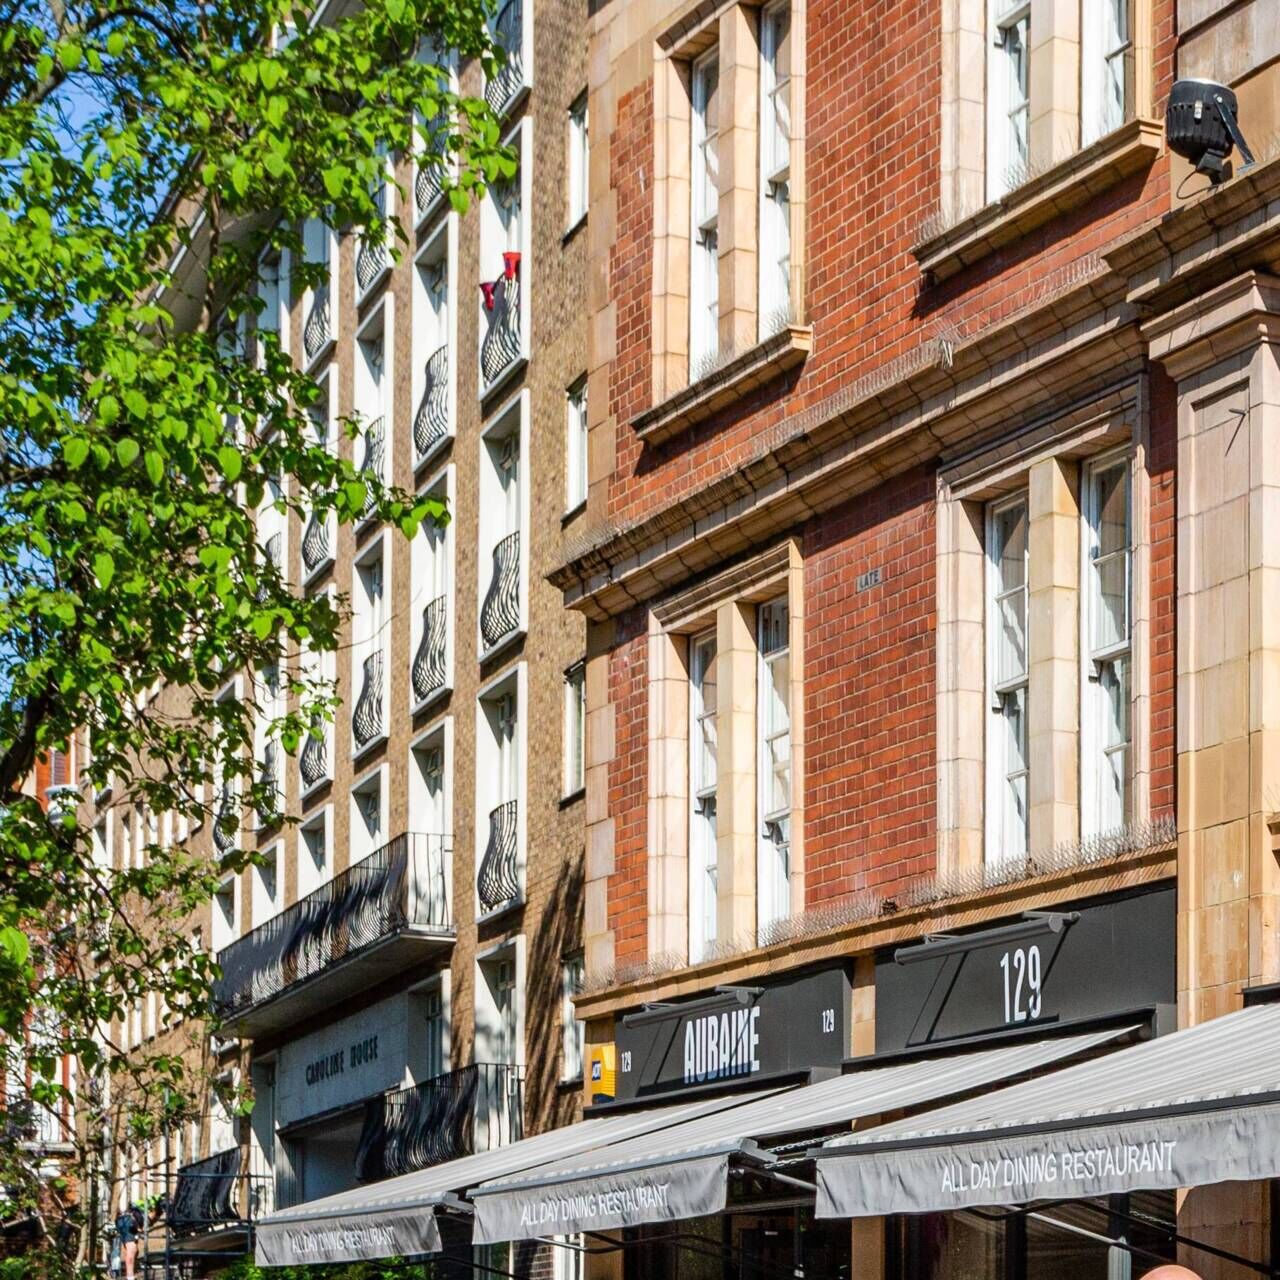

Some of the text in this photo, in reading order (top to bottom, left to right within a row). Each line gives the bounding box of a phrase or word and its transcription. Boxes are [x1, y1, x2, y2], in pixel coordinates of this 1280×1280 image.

[1000, 945, 1041, 1023] 129
[822, 1009, 834, 1033] 129
[350, 1034, 378, 1069] HOUSE
[621, 1051, 632, 1072] 129
[684, 1006, 760, 1083] AUBAINE
[942, 1141, 1177, 1192] ALL DAY DINING RESTAURANT
[521, 1184, 670, 1226] ALL DAY DINING RESTAURANT
[345, 1226, 395, 1249] RESTAURANT
